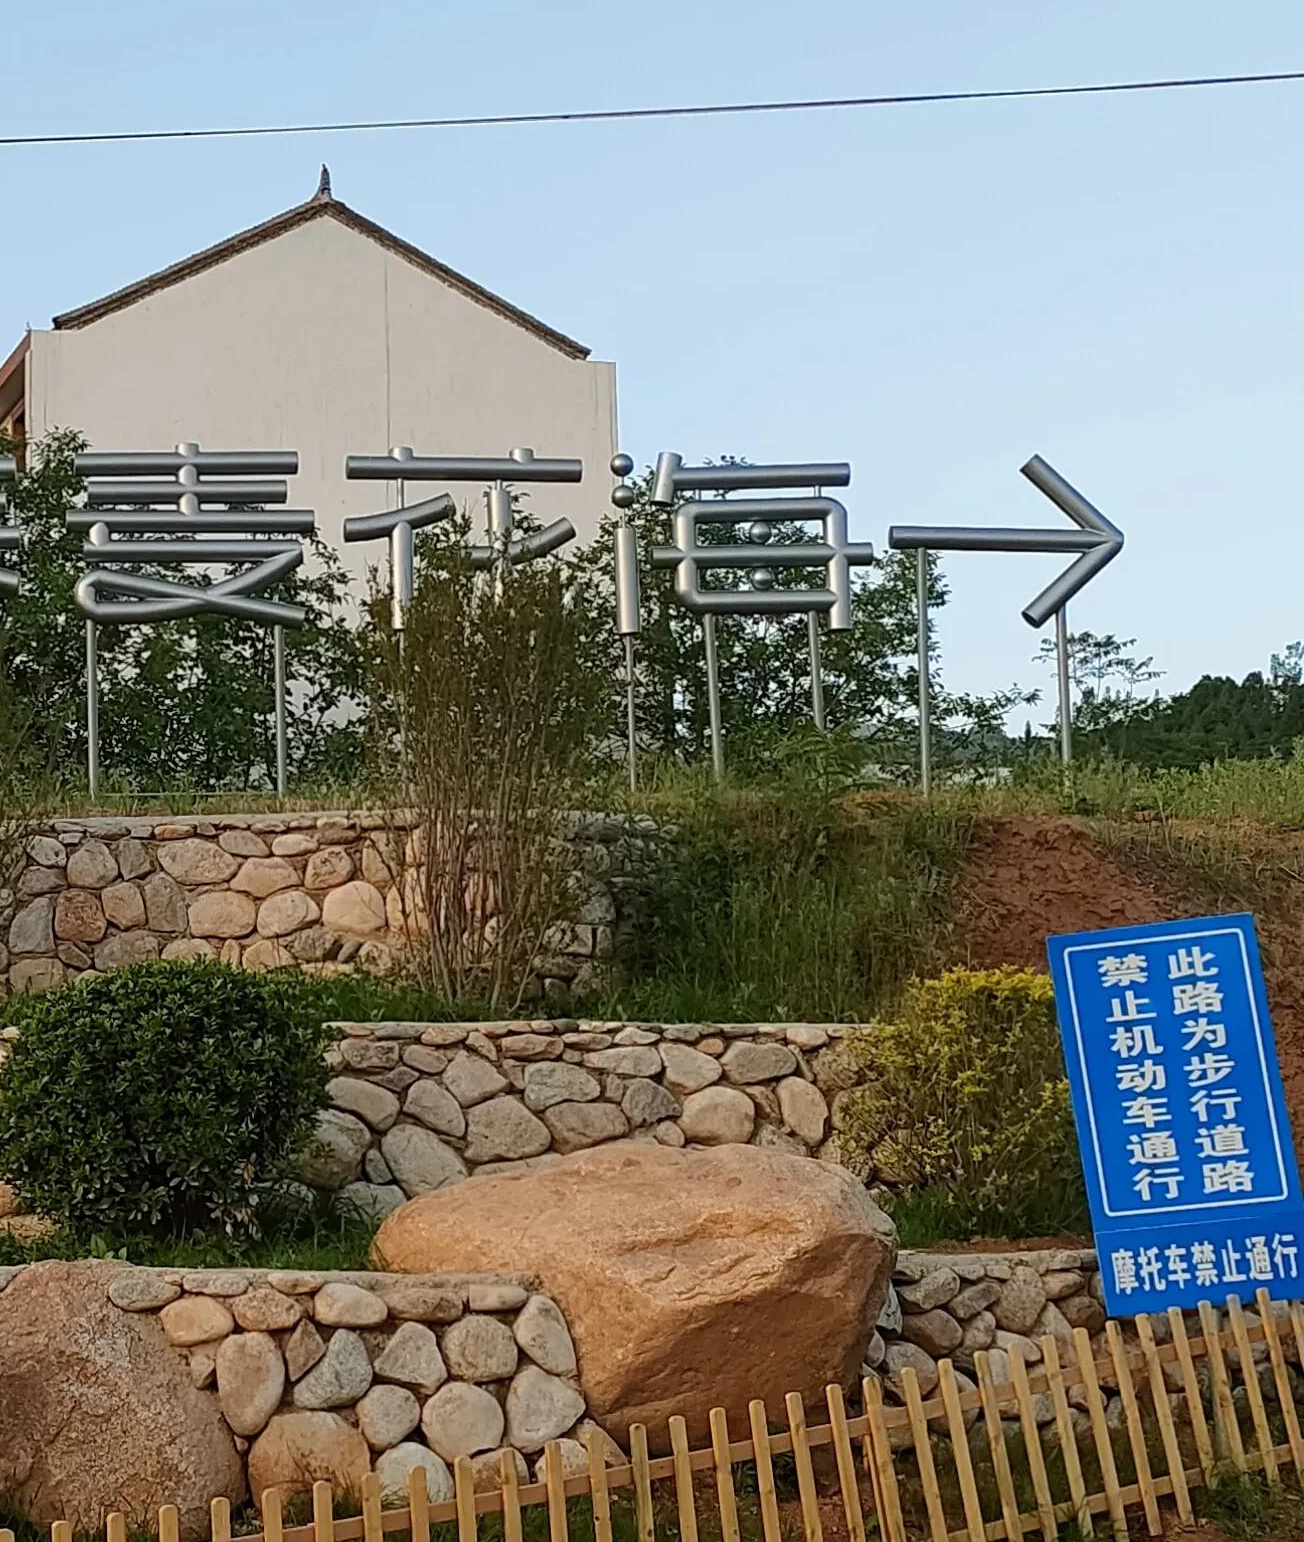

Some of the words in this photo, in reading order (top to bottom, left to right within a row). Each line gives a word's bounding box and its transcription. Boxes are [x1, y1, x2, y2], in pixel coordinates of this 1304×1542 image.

[1097, 953, 1185, 1202] 禁止机动车通行
[1167, 946, 1255, 1194] 此路为步行道路
[1111, 1233, 1298, 1295] 摩托车禁止通行
